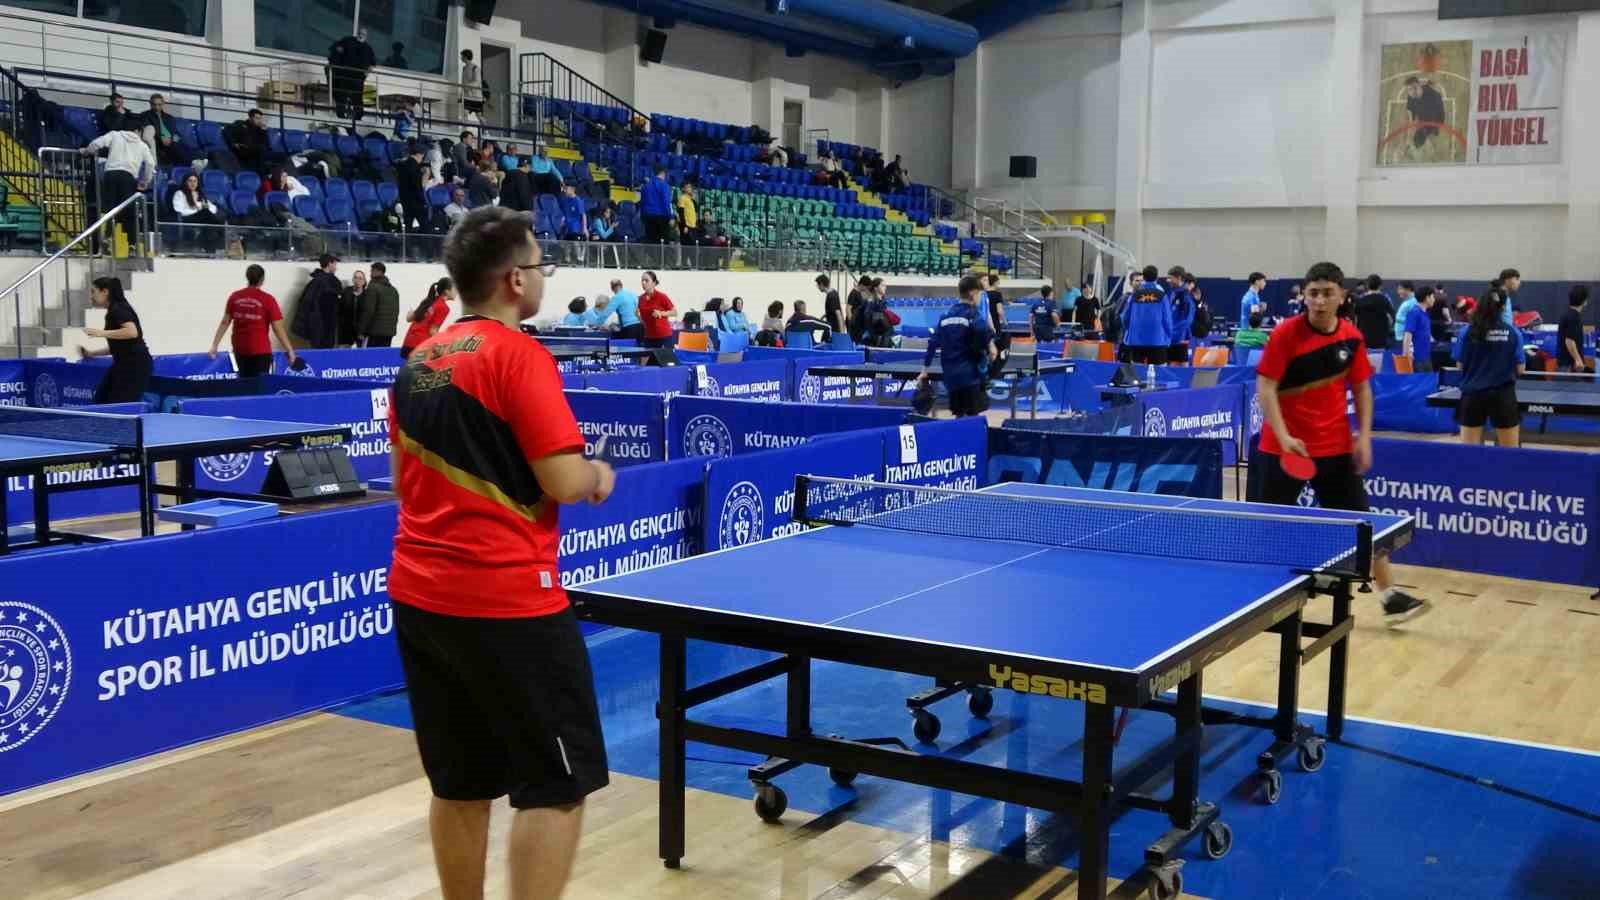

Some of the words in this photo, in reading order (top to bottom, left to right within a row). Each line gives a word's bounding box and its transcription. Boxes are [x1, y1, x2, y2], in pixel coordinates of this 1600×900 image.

[1476, 115, 1548, 146] YÜKSEL
[374, 398, 387, 409] 14
[1528, 404, 1554, 413] JOOLA
[629, 424, 648, 438] VE
[903, 434, 915, 449] 15
[963, 453, 976, 469] VE
[1459, 487, 1552, 514] GENÇLİK
[1556, 496, 1585, 516] VE
[630, 505, 685, 540] GENÇLİK
[1415, 507, 1433, 530] İL
[1439, 512, 1588, 545] MÜDÜRLÜĞÜ
[103, 596, 240, 649] KÜTAHYA
[247, 571, 356, 617] GENÇLİK
[360, 567, 388, 593] VE
[98, 655, 182, 701] SPOR
[190, 640, 215, 679] İL
[222, 605, 393, 672] MÜDÜRLÜĞÜ
[989, 663, 1106, 704] Yasaka
